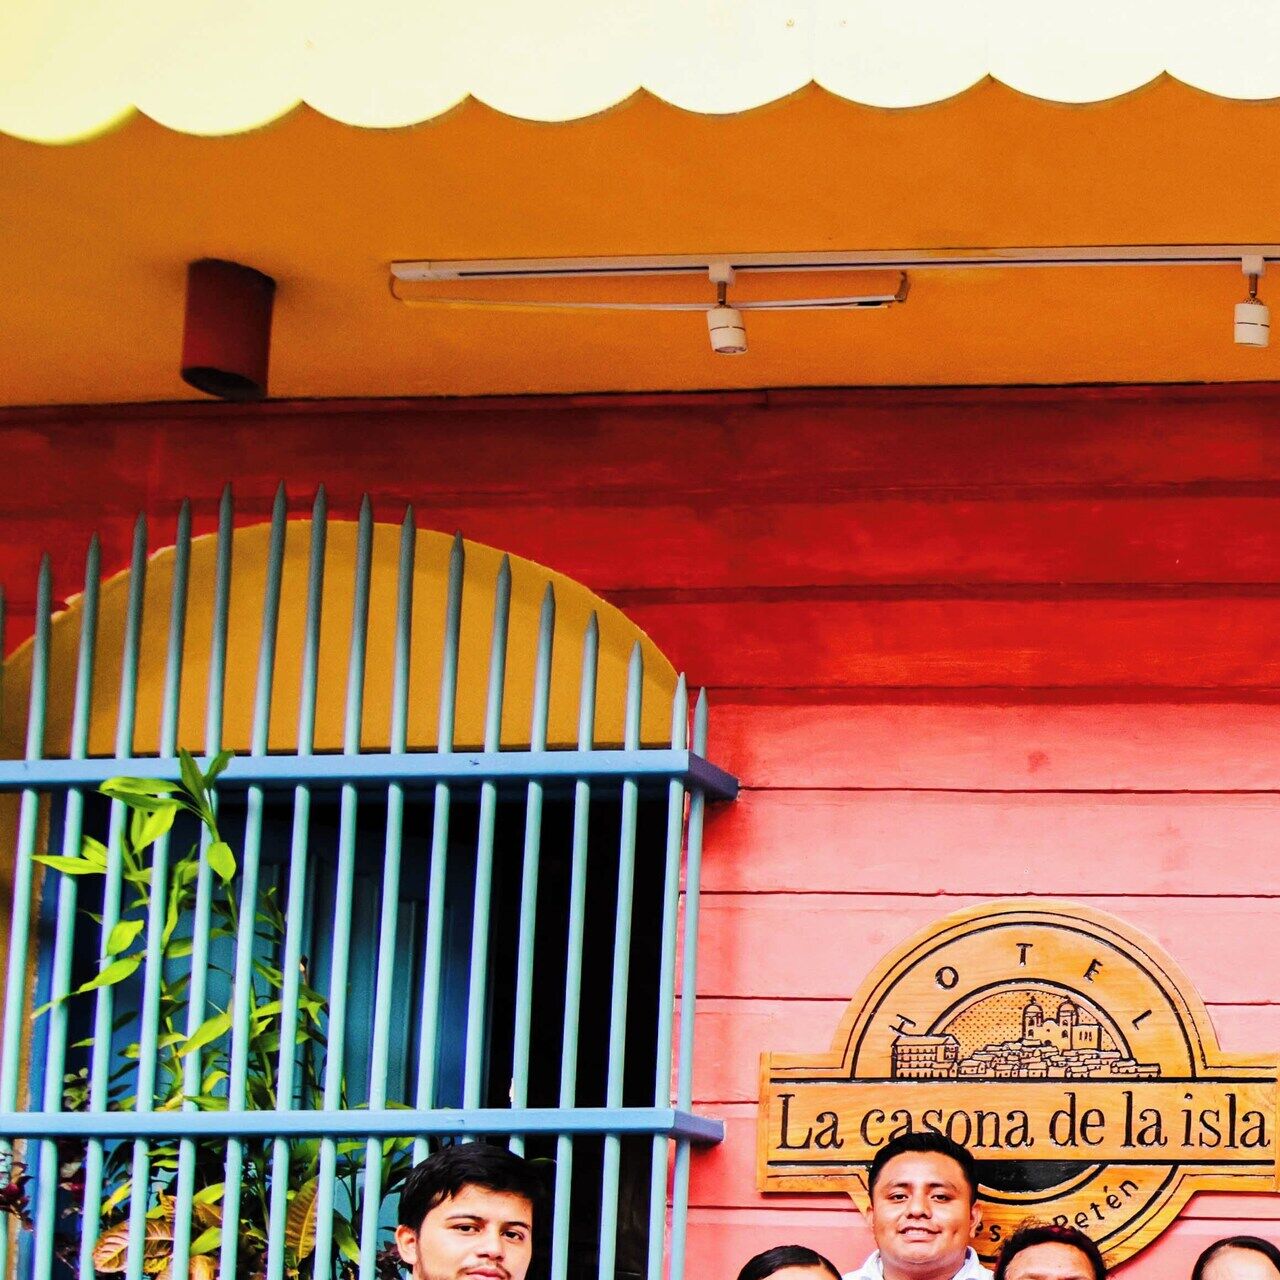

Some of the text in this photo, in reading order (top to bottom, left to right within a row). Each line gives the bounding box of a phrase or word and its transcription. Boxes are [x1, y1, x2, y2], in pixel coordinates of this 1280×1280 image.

[888, 943, 1153, 1036] HOTEL
[776, 1090, 1271, 1150] La casona de la isla
[1052, 1179, 1139, 1230] Petén
